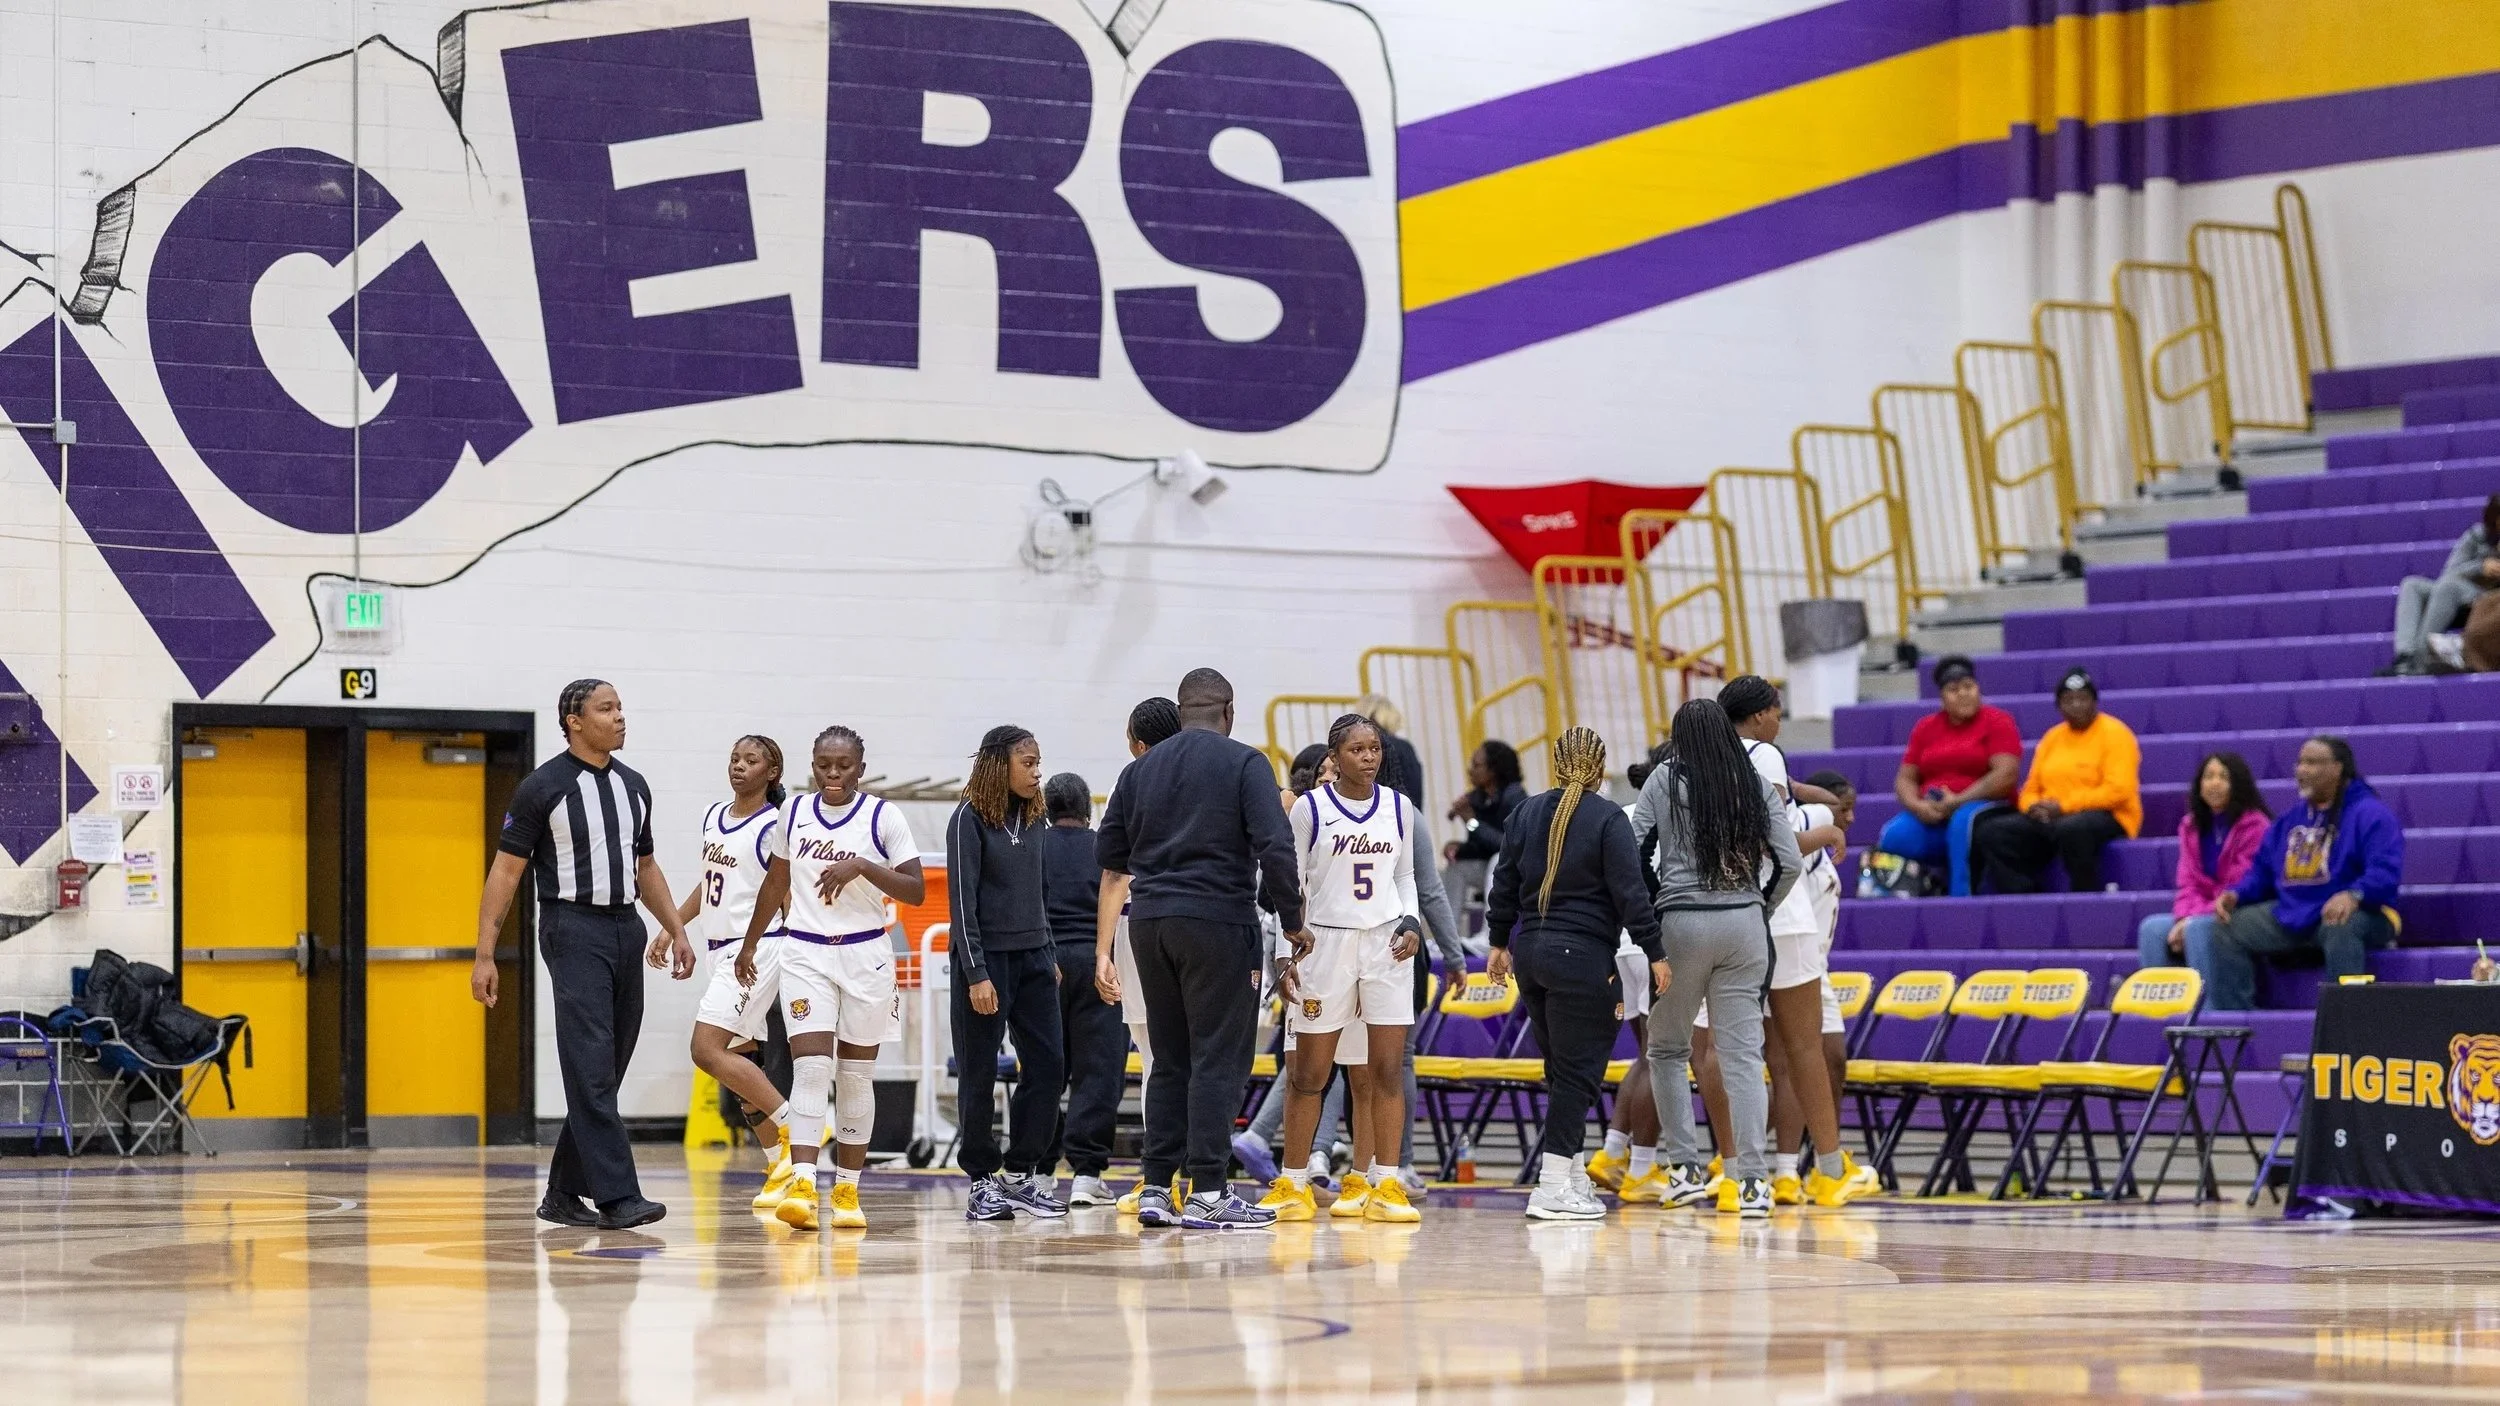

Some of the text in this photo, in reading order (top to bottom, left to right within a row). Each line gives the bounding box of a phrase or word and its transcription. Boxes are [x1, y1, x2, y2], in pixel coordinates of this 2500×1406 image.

[0, 2, 1371, 865] IGERS
[346, 592, 383, 628] EXIT
[345, 670, 375, 697] G9
[1332, 833, 1394, 856] Wilson
[705, 869, 725, 908] 13
[1353, 863, 1374, 901] 5
[1458, 985, 1506, 1002] IGERS
[1892, 984, 1943, 1001] TIGERS
[1968, 984, 2016, 1002] TIGER
[2023, 983, 2075, 1001] TIGERS
[2131, 982, 2188, 1000] TIGERS
[2311, 1053, 2446, 1109] TIGER
